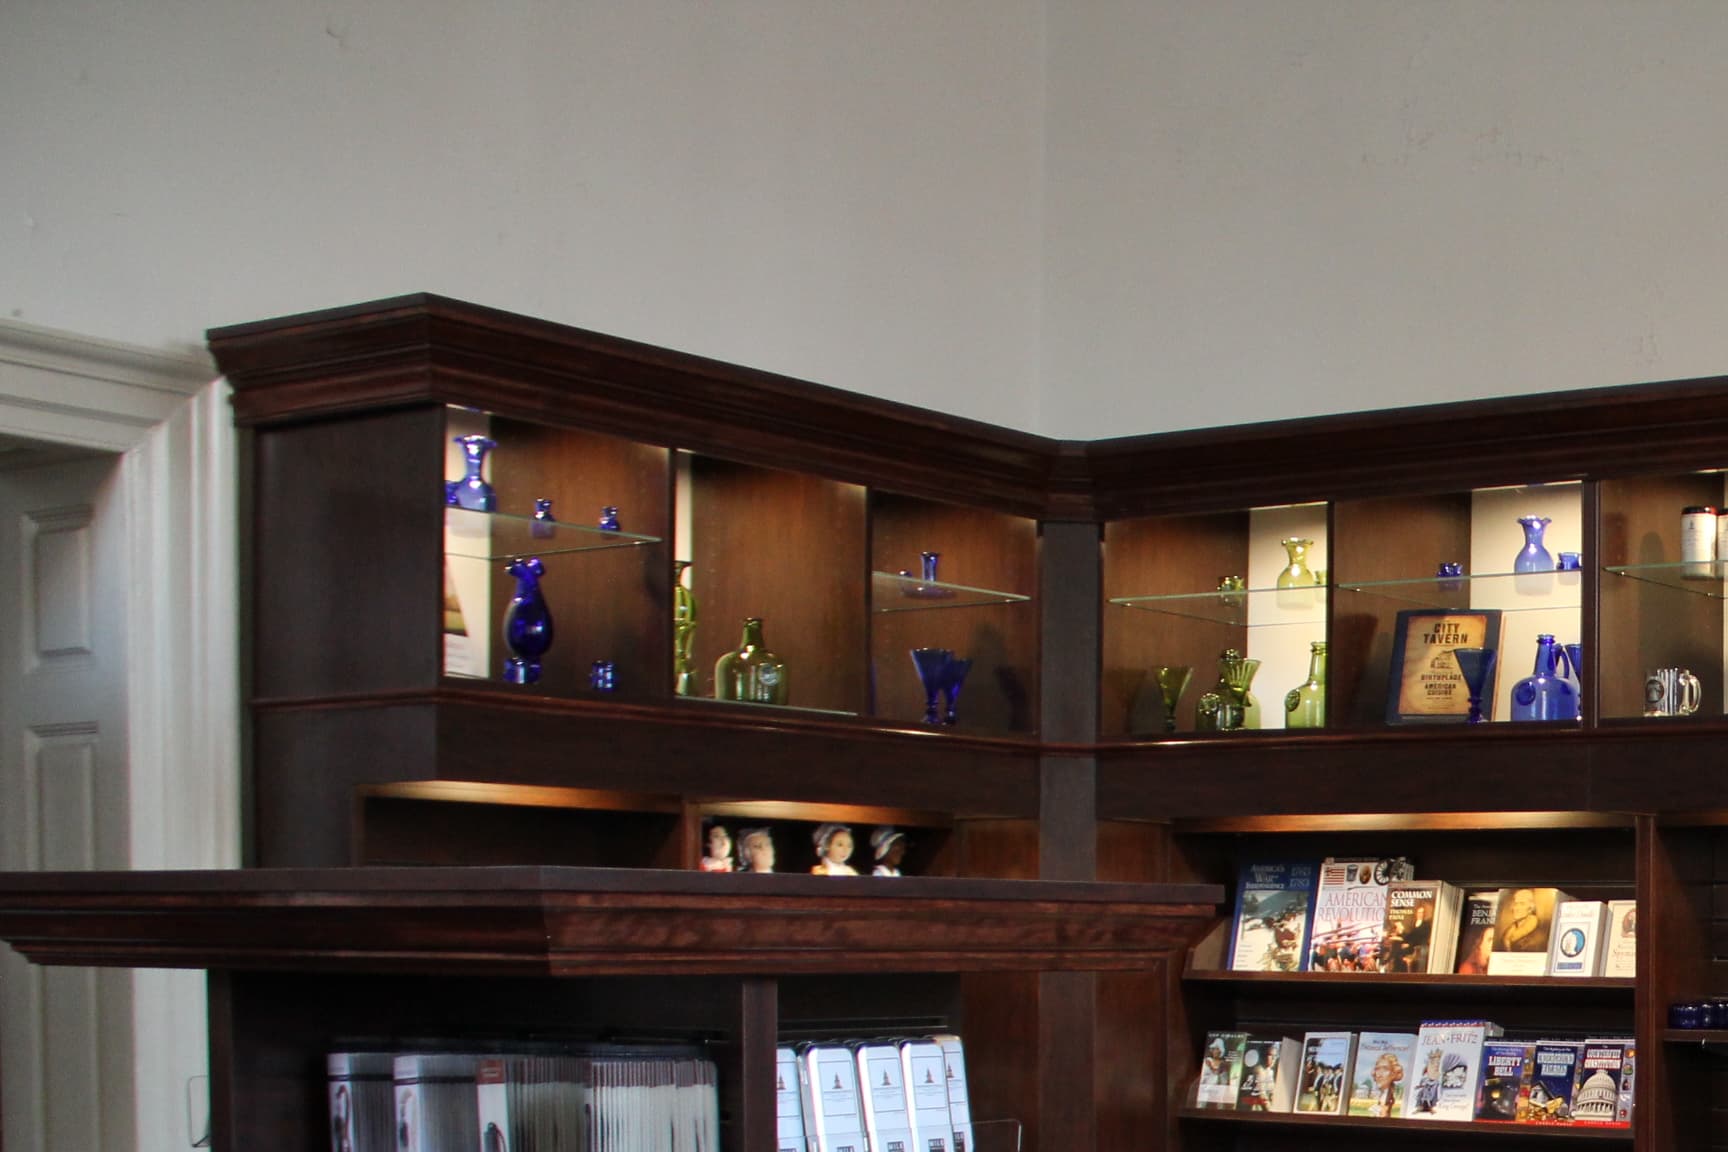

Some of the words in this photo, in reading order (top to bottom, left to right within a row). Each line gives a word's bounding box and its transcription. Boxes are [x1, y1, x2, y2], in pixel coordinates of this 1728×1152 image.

[1434, 623, 1461, 633] CITY
[1424, 634, 1468, 644] TAVERN
[1326, 892, 1387, 906] AMERICAN
[1391, 890, 1433, 899] COMMON
[1390, 898, 1415, 908] SENSE
[1450, 1032, 1479, 1044] FRITZ
[1488, 1056, 1522, 1066] LIBERTY
[1494, 1066, 1514, 1076] BELL
[888, 1142, 904, 1150] MILK
[929, 1138, 944, 1147] MILK
